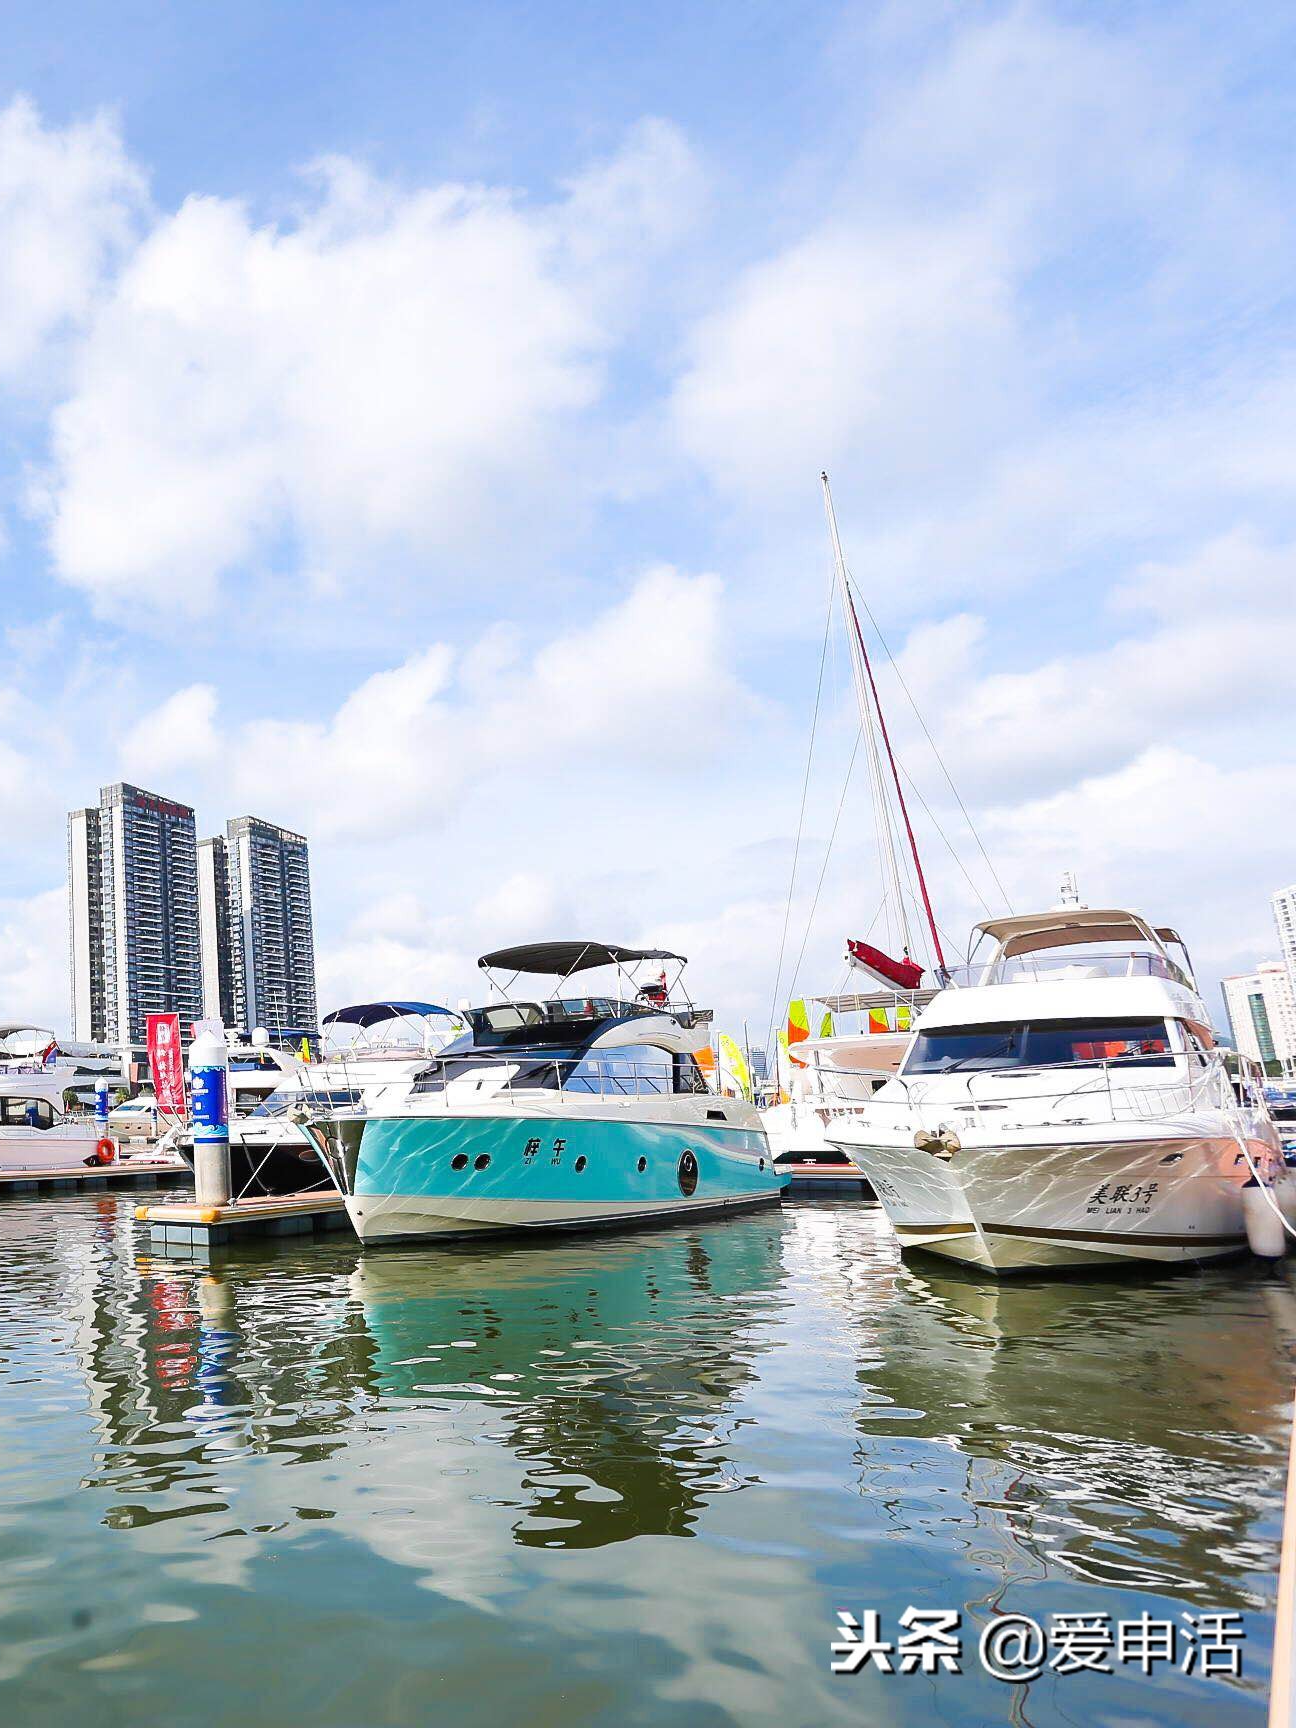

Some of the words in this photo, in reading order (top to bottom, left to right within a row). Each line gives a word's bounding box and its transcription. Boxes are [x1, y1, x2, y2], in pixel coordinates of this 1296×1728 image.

[1088, 1182, 1160, 1204] 美联3号
[1136, 1206, 1151, 1214] HAO
